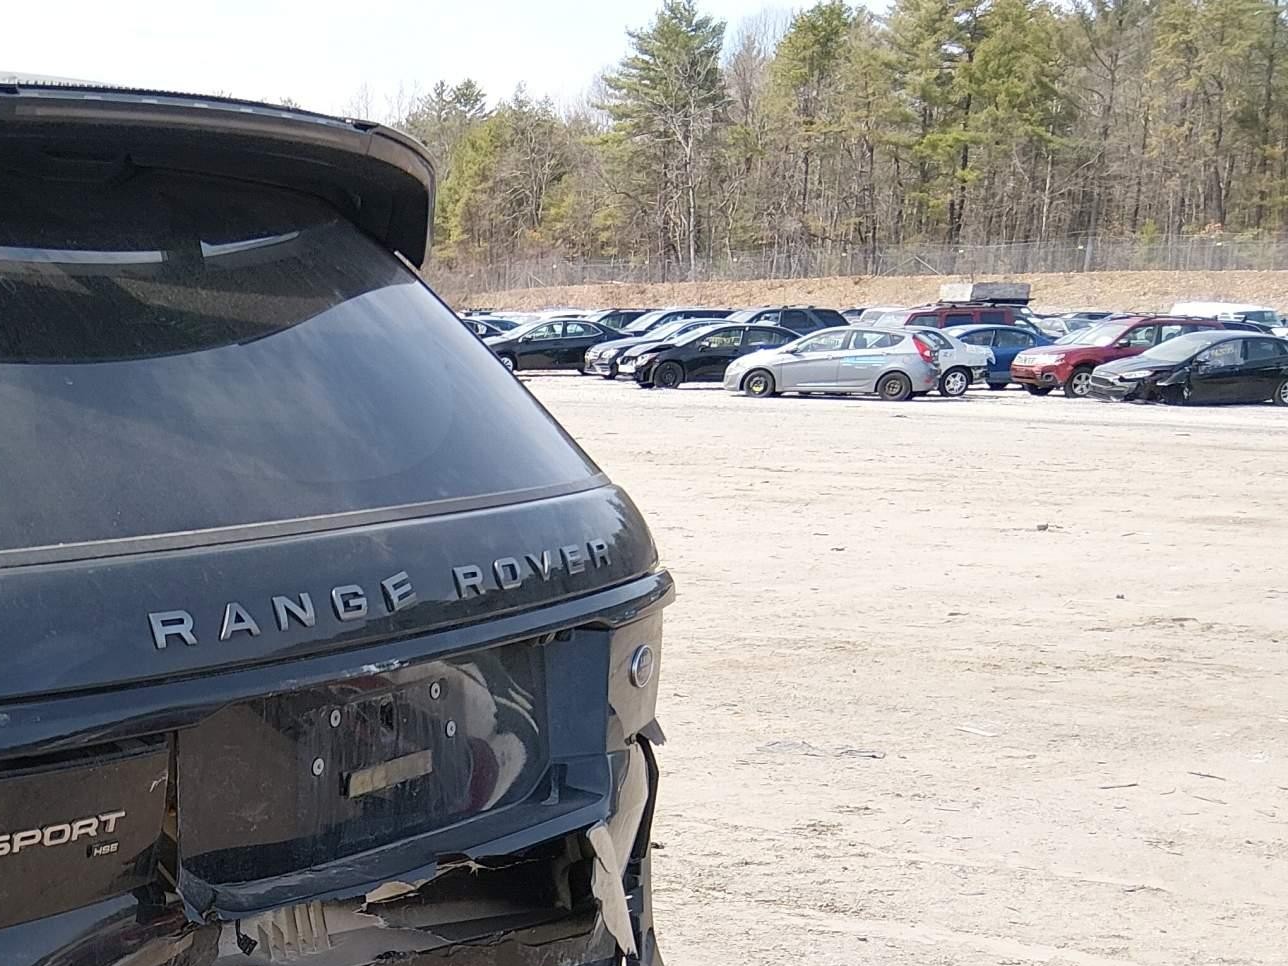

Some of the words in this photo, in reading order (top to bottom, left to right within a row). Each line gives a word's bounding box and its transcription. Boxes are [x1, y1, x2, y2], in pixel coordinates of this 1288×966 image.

[148, 571, 417, 649] RANGE
[452, 538, 613, 600] ROVER
[93, 842, 119, 857] HSE
